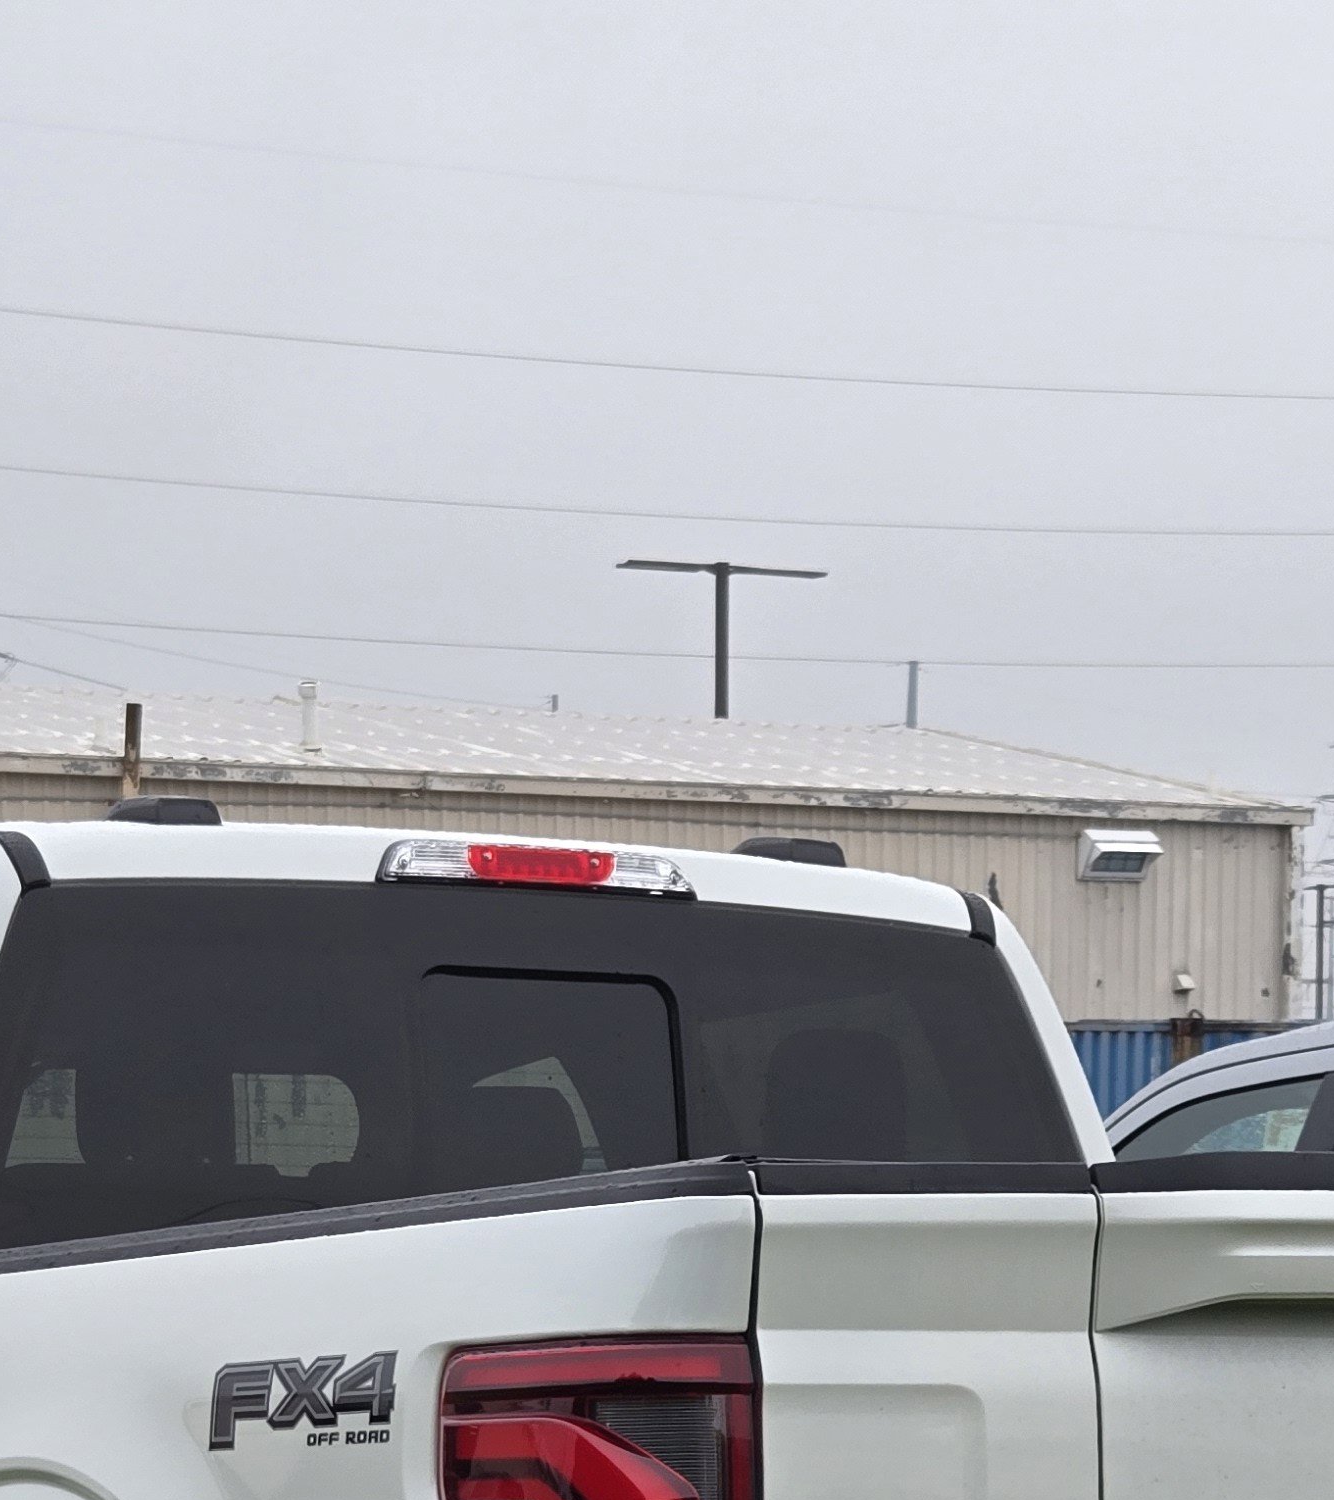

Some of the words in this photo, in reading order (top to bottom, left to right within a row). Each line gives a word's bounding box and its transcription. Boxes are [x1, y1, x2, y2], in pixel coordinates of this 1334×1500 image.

[208, 1350, 398, 1451] FX4
[306, 1431, 340, 1446] OFF
[345, 1429, 390, 1445] ROAD
